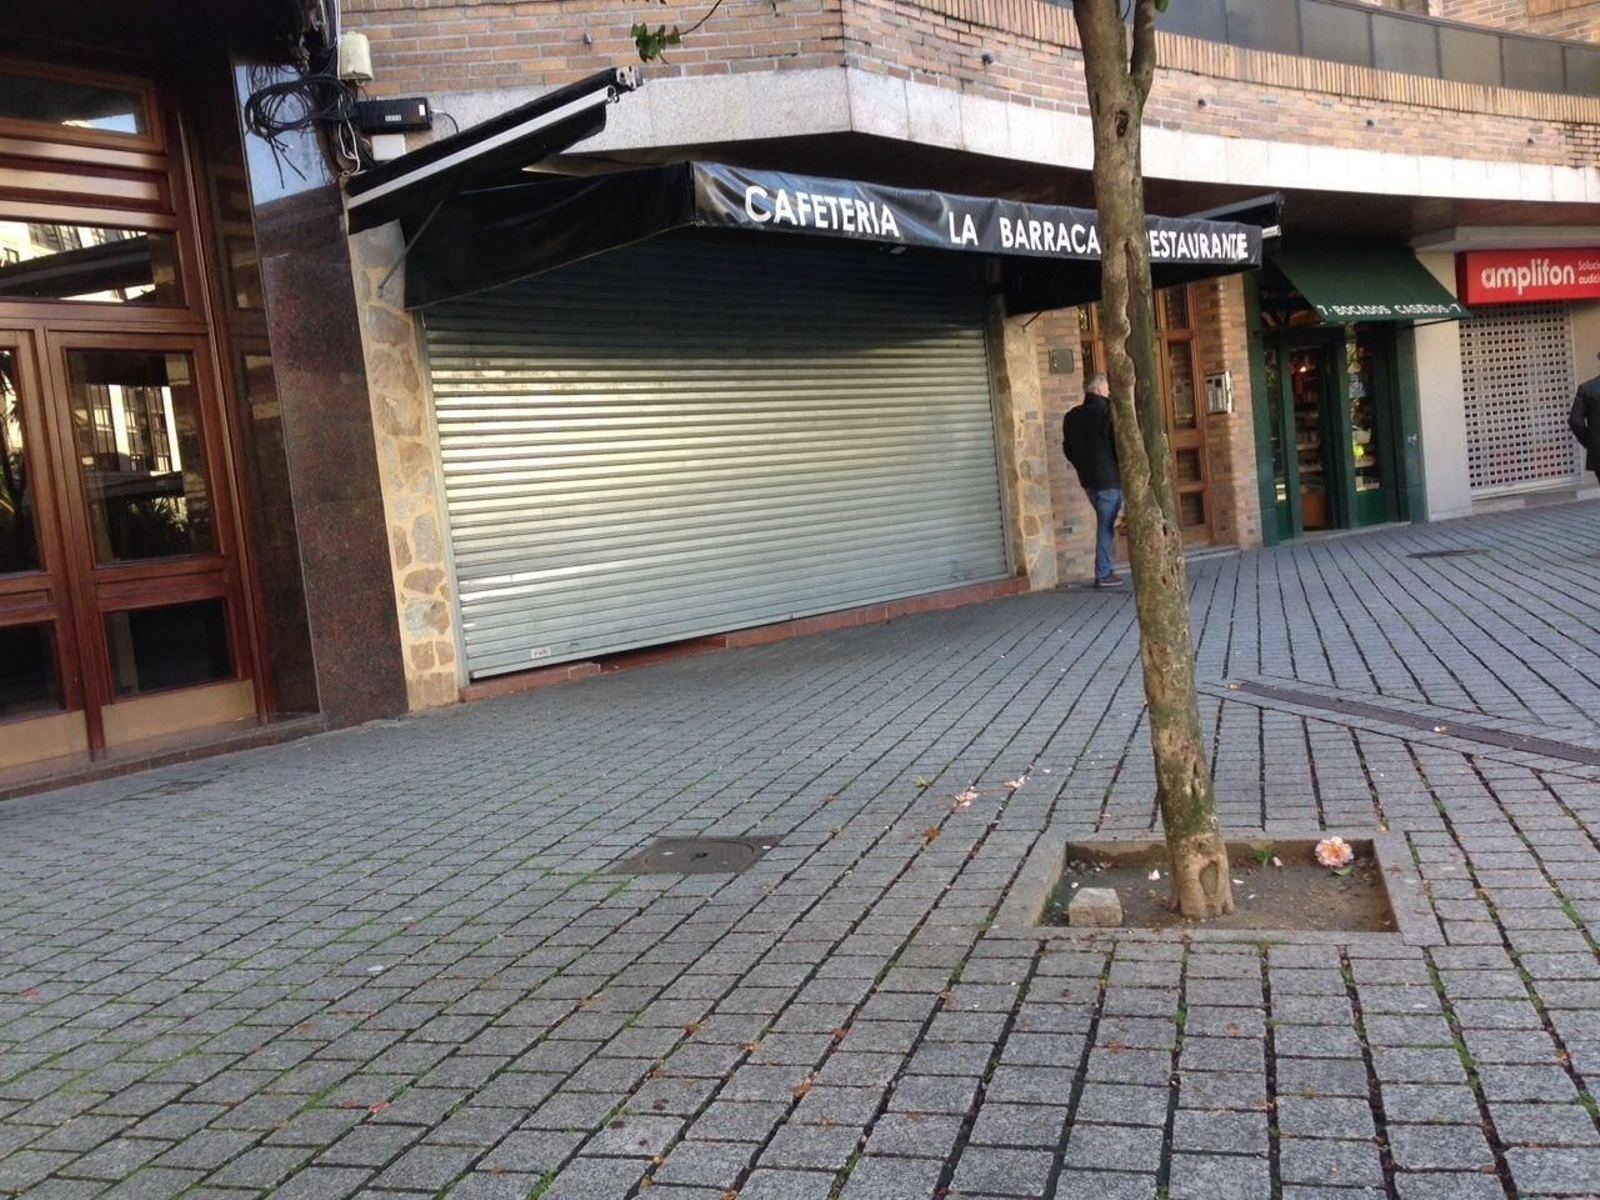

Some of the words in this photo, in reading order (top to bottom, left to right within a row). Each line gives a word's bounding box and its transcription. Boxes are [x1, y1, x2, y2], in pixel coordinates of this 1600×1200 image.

[745, 185, 900, 237] CAFETERIA
[949, 211, 979, 246] LA
[999, 217, 1102, 255] BARRACA
[1145, 230, 1248, 260] ESTAURANTE
[1481, 258, 1575, 296] amplifon
